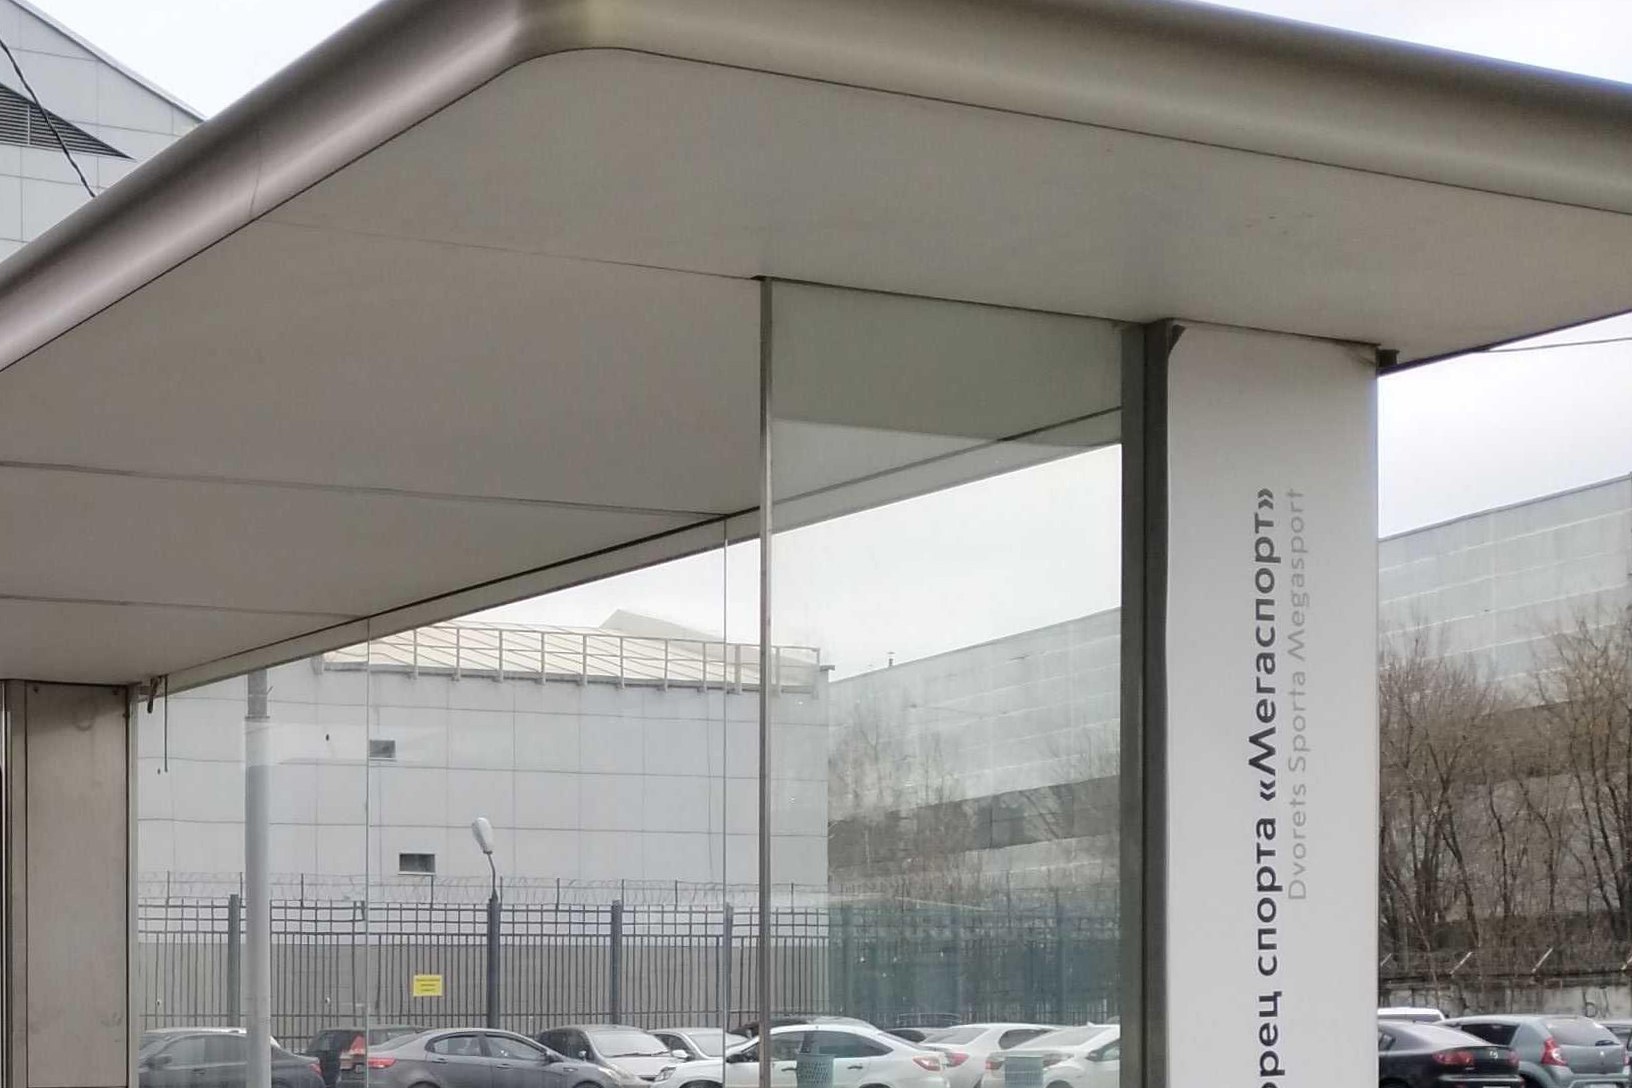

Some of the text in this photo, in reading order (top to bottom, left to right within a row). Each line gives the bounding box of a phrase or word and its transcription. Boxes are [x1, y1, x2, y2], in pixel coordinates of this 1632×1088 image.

[1247, 488, 1281, 801] «Мегаспорт»
[1287, 488, 1310, 900] Dvorets Sporta Megasport
[1255, 817, 1283, 976] спорта
